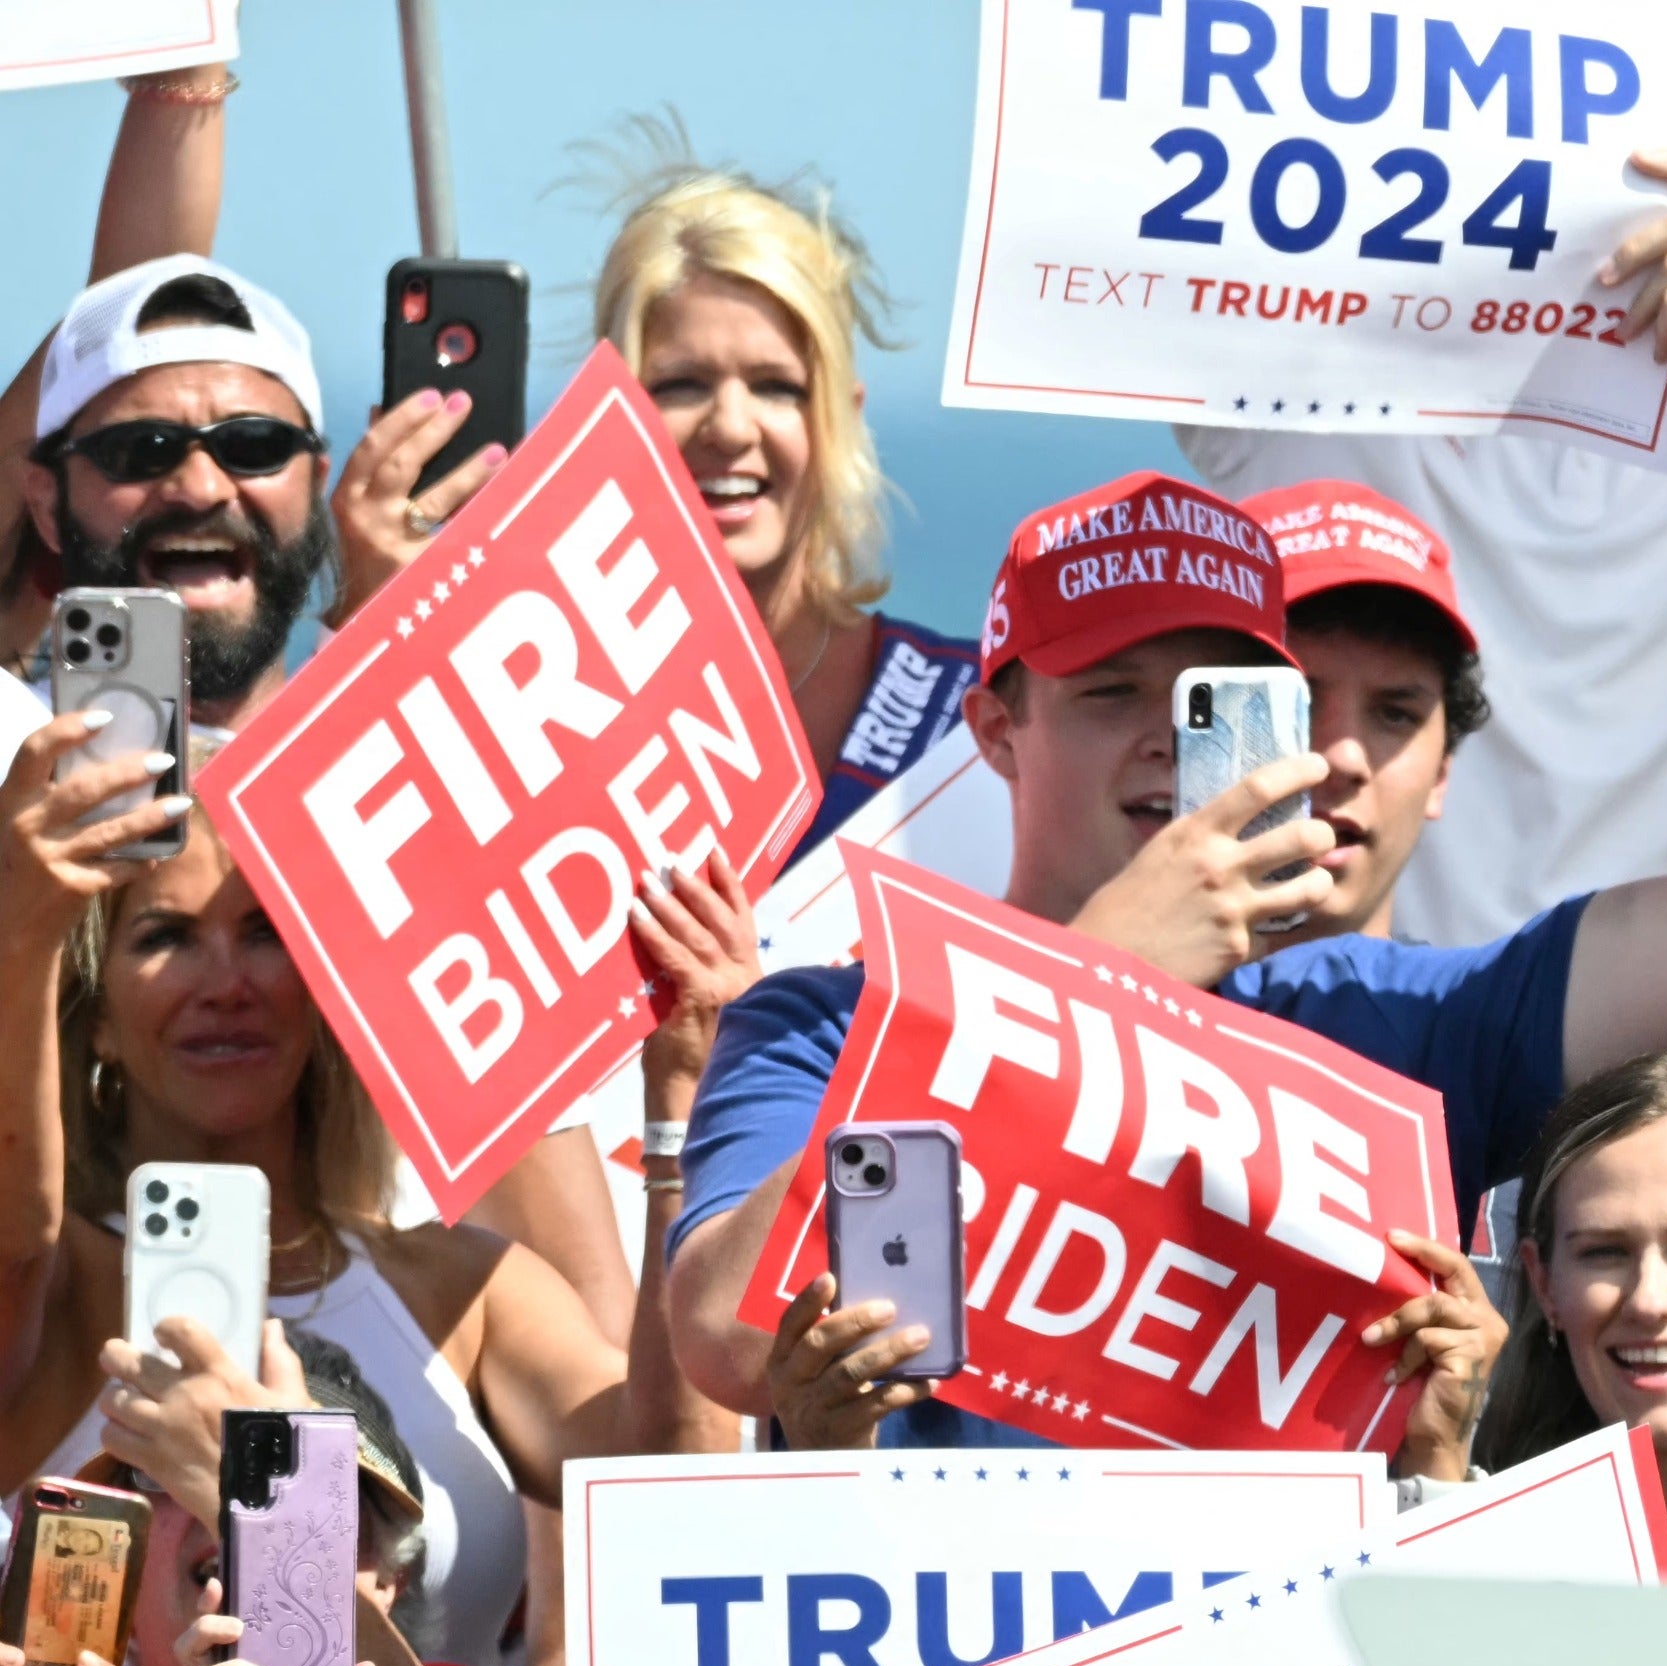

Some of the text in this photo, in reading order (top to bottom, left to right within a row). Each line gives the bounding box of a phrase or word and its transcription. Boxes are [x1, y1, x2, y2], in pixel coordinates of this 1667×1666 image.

[1072, 0, 1641, 146] TRUMP
[1138, 127, 1557, 272] 2024
[1034, 263, 1627, 348] TEXT TRUMP TO 88022
[1035, 494, 1275, 568] MAKE AMERICA
[1058, 546, 1264, 611] GREAT AGAIN
[1261, 504, 1323, 539] AKE
[1275, 525, 1350, 558] REAT
[301, 478, 693, 940] FIRE
[841, 641, 944, 773] TRUMP
[406, 661, 762, 1086] BIDEN
[927, 940, 1386, 1286] FIRE
[966, 1180, 1346, 1431] IDEN
